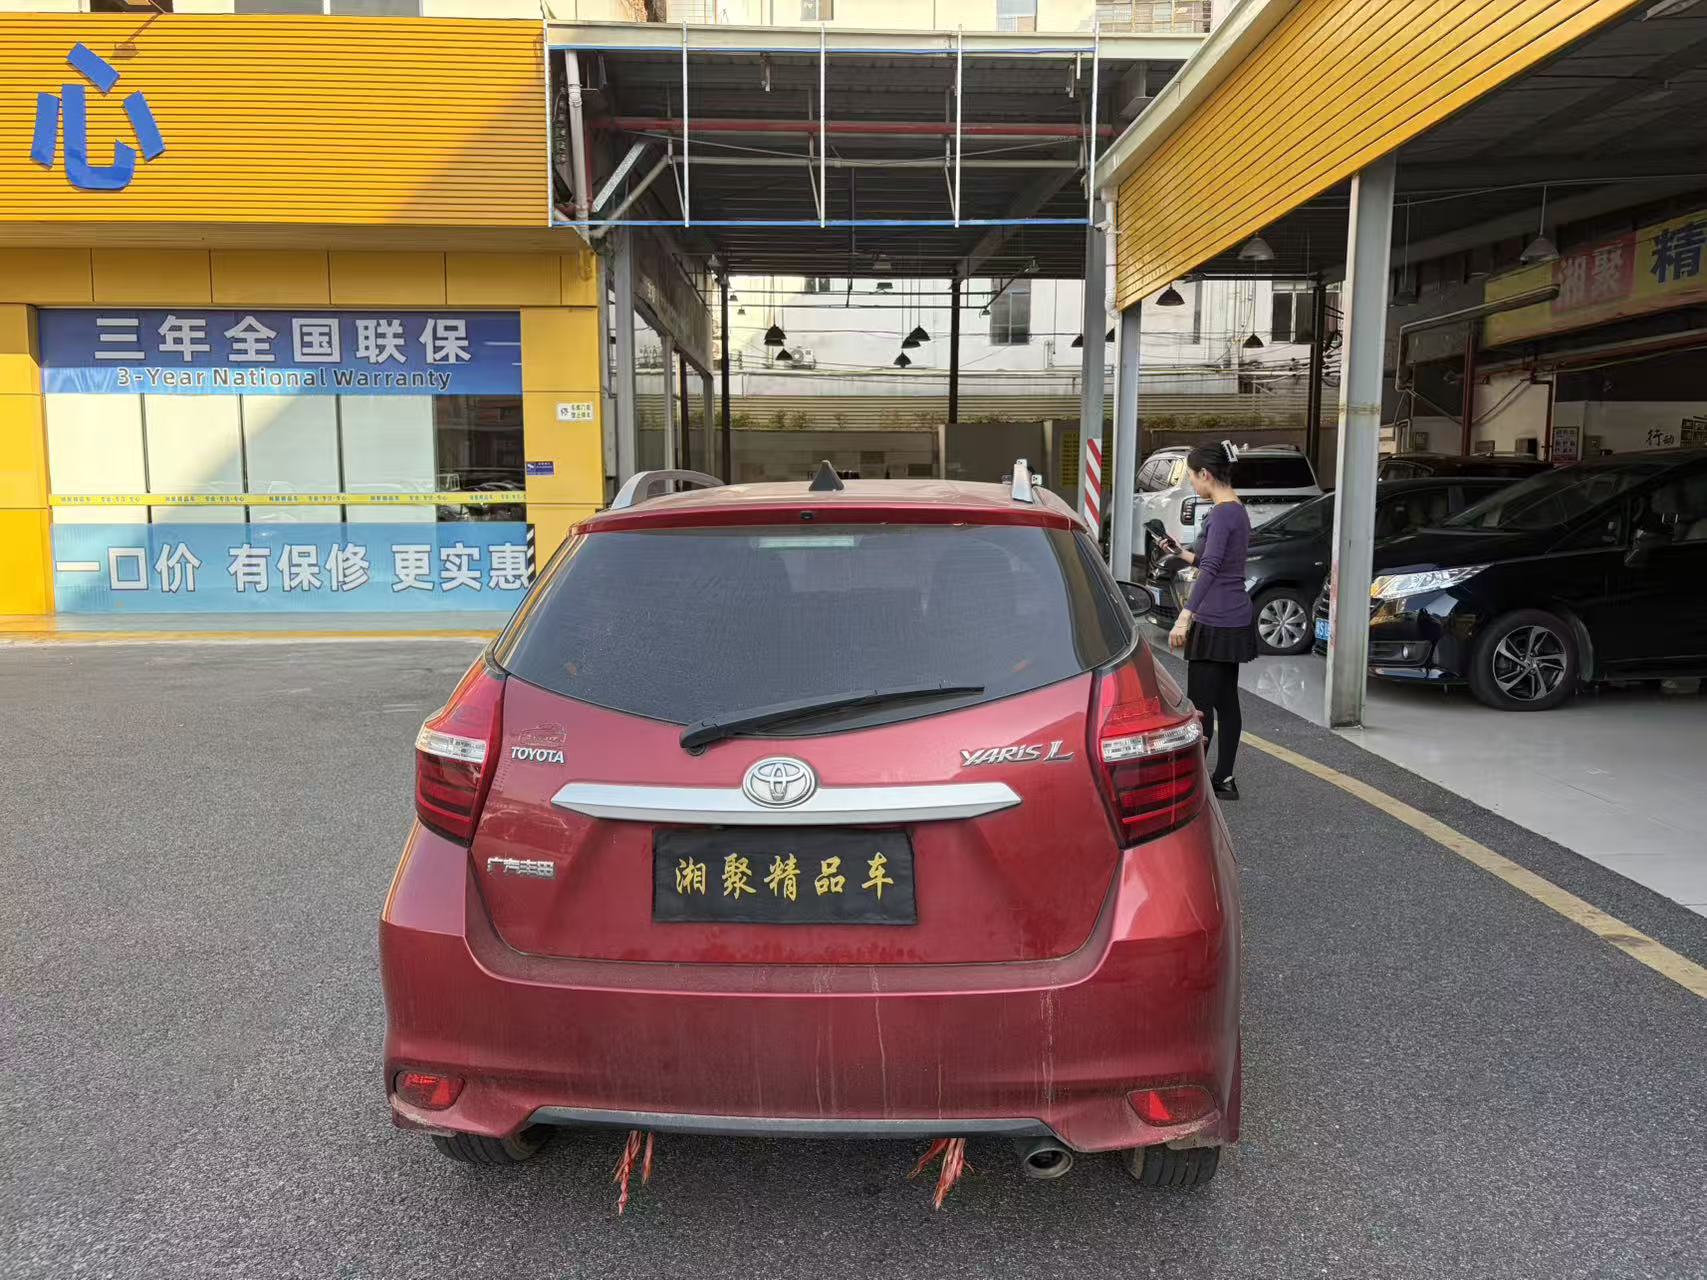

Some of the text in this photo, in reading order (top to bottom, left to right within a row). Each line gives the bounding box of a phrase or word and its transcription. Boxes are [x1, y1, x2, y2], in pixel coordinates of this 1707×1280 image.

[31, 42, 166, 191] 心
[1650, 222, 1707, 283] 精
[94, 314, 472, 364] 三年全国联保
[116, 366, 453, 391] 3-Year National Warranty
[56, 542, 530, 592] 一口价 有保修 更实惠
[511, 746, 565, 764] TOYOTA
[1044, 740, 1075, 761] L
[487, 857, 556, 880] 广汽丰田
[675, 852, 894, 902] 湘聚精品车
